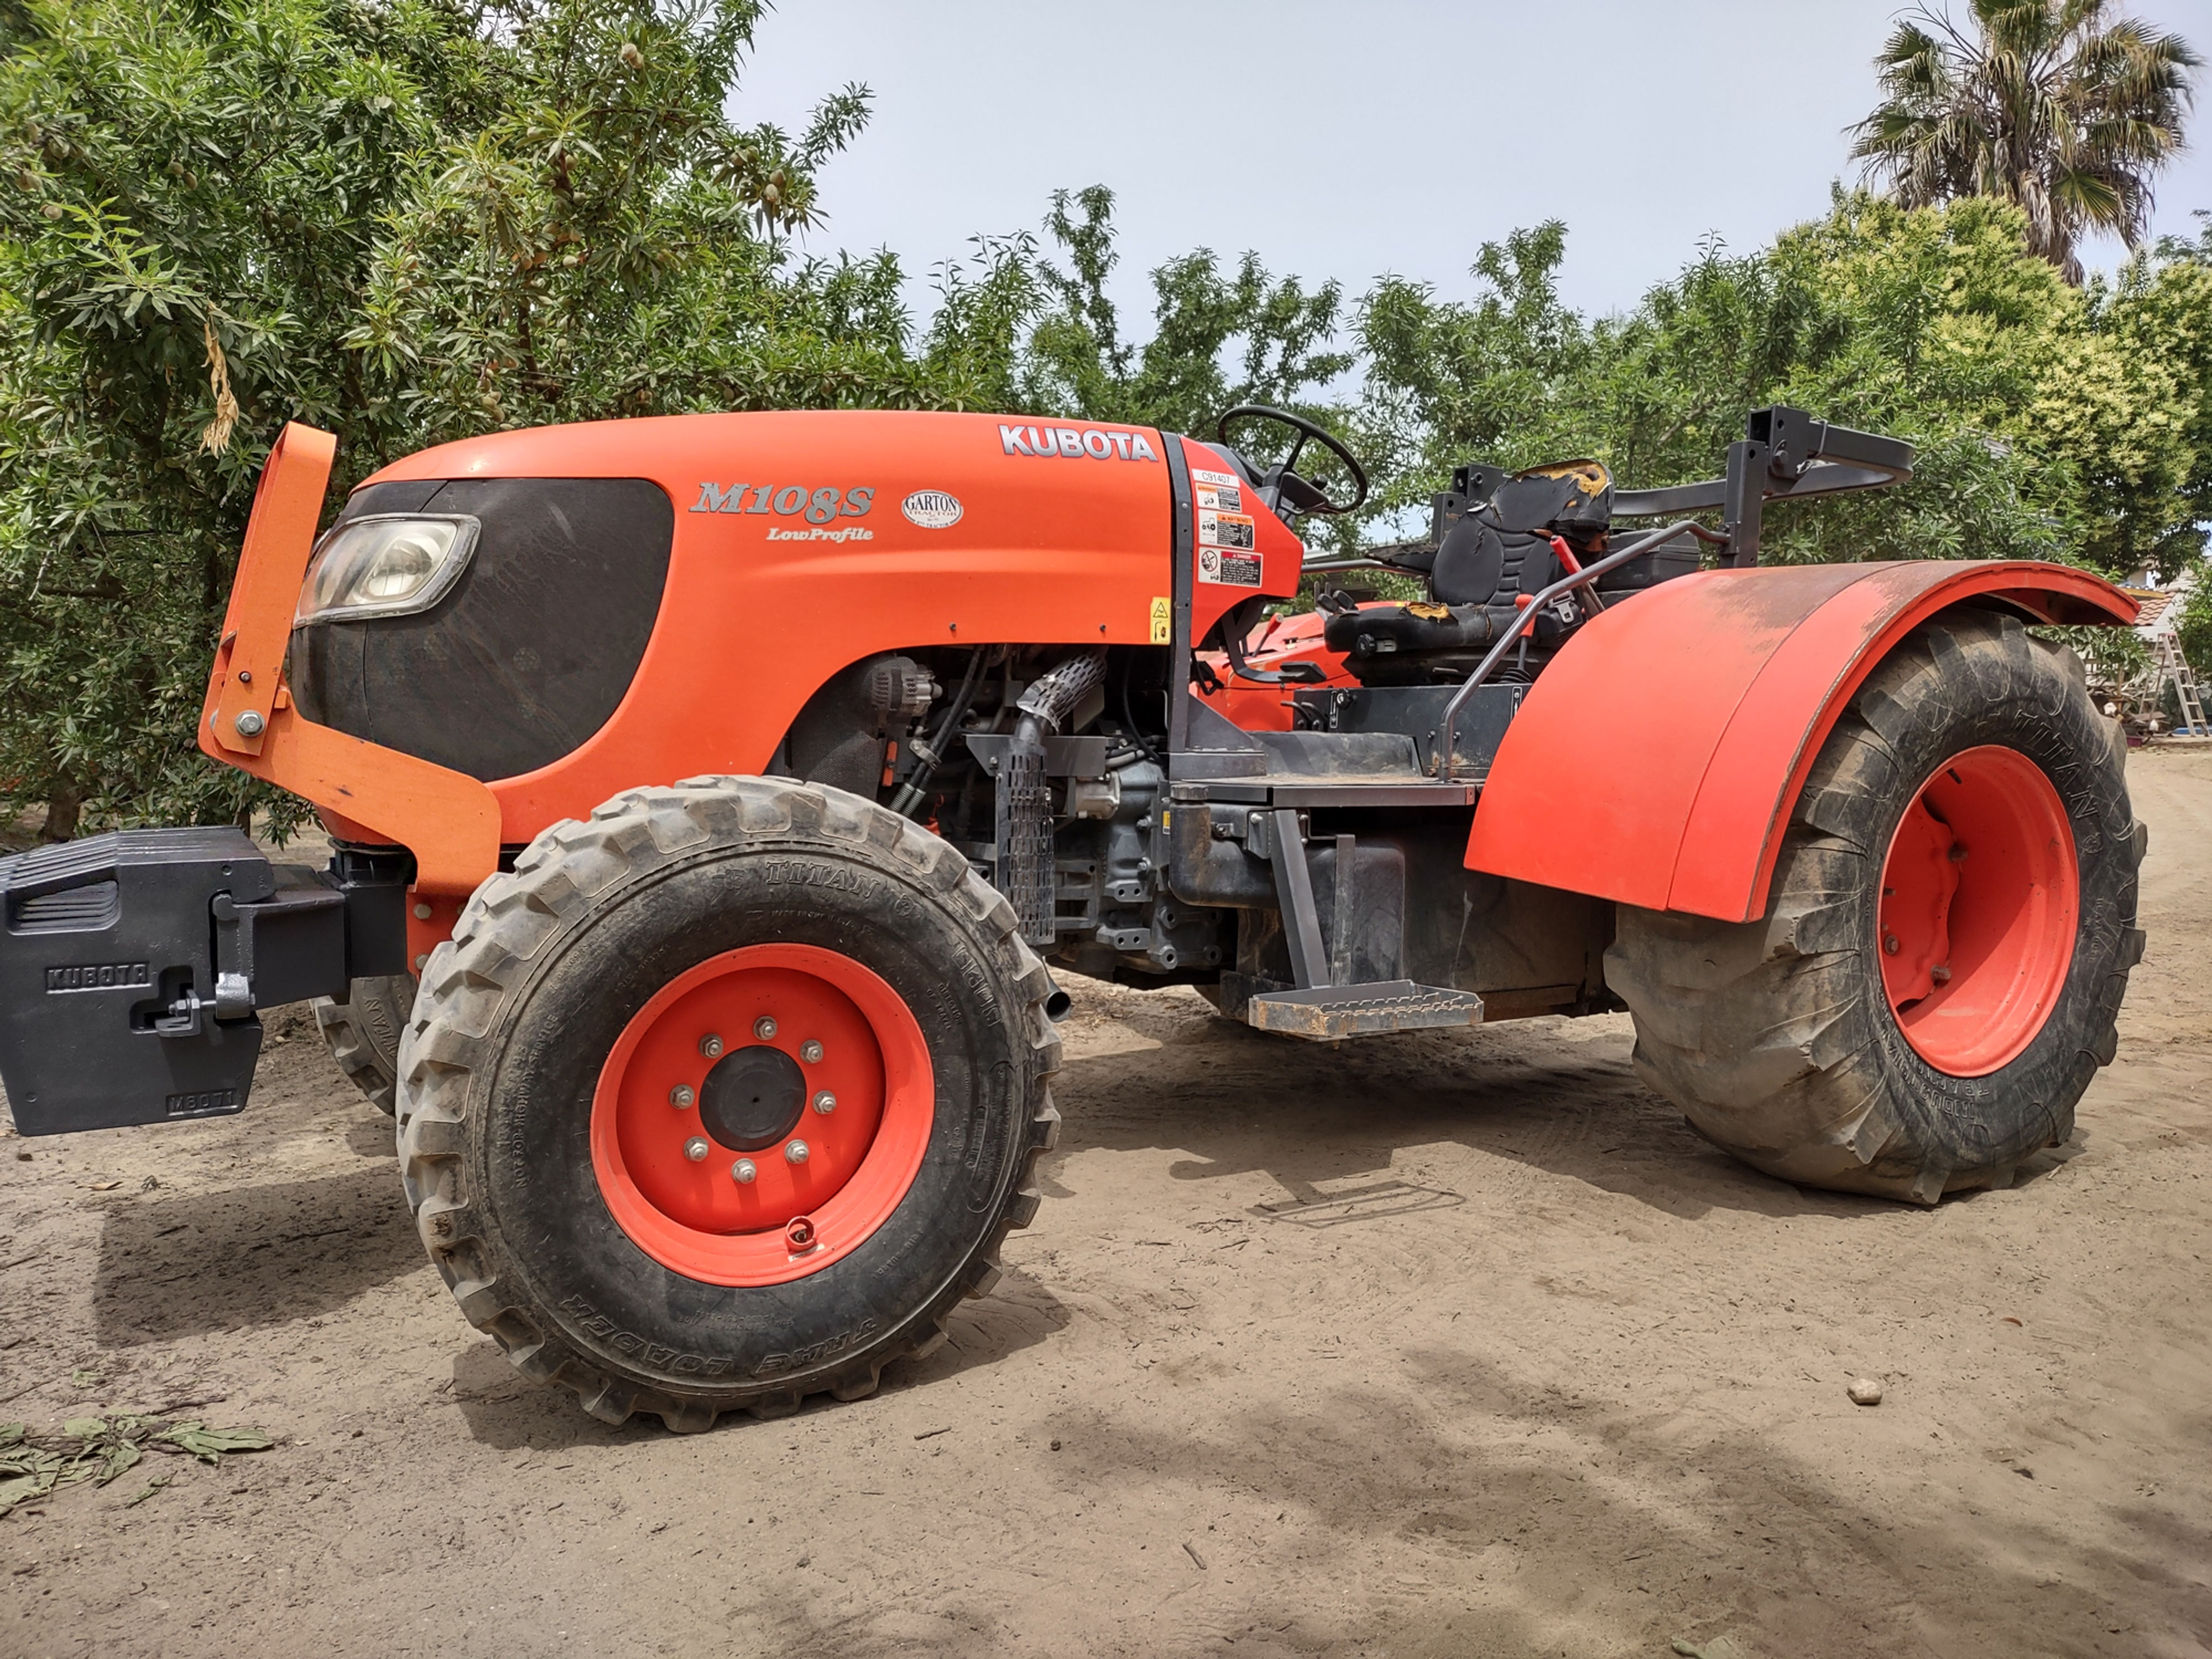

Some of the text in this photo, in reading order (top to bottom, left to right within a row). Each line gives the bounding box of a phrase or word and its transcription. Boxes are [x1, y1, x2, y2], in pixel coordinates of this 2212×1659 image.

[999, 424, 1159, 462] KUBOTA
[1202, 472, 1230, 484] C91407
[688, 483, 876, 524] M108S
[905, 495, 957, 512] GARTON
[766, 528, 874, 543] LowProfile
[2005, 709, 2100, 818] TITAN
[765, 860, 880, 899] TITAN
[48, 963, 150, 989] KUBOTA
[363, 997, 398, 1058] ITAN
[170, 1091, 232, 1111] M8071
[561, 1293, 878, 1375] TRAC LOADER
